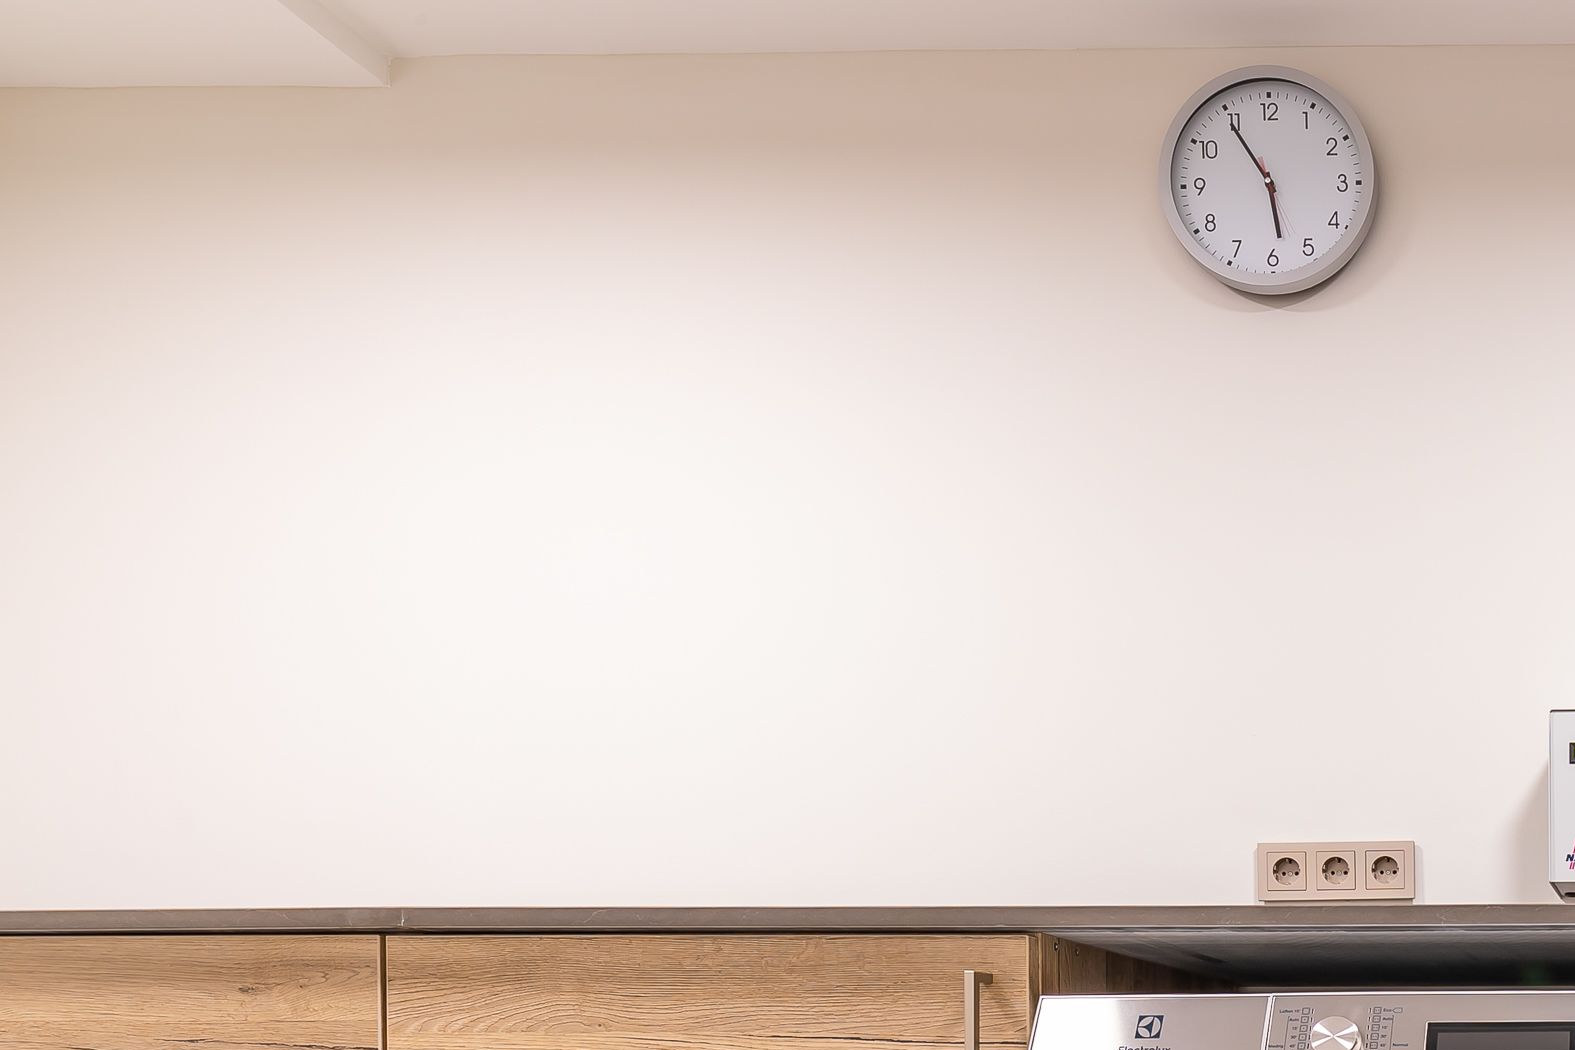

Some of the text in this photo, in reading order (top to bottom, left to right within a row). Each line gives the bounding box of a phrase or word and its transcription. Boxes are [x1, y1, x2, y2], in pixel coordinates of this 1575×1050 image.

[1260, 102, 1279, 121] 12
[1302, 111, 1309, 129] 1
[1227, 113, 1241, 131] 11
[1199, 140, 1218, 159] 10
[1326, 138, 1338, 156] 2
[1193, 177, 1206, 196] 9
[1336, 173, 1349, 192] 3
[1204, 213, 1217, 232] 8
[1327, 211, 1340, 229] 4
[1232, 240, 1242, 258] 7
[1302, 238, 1315, 256] 5
[1267, 248, 1279, 266] 6
